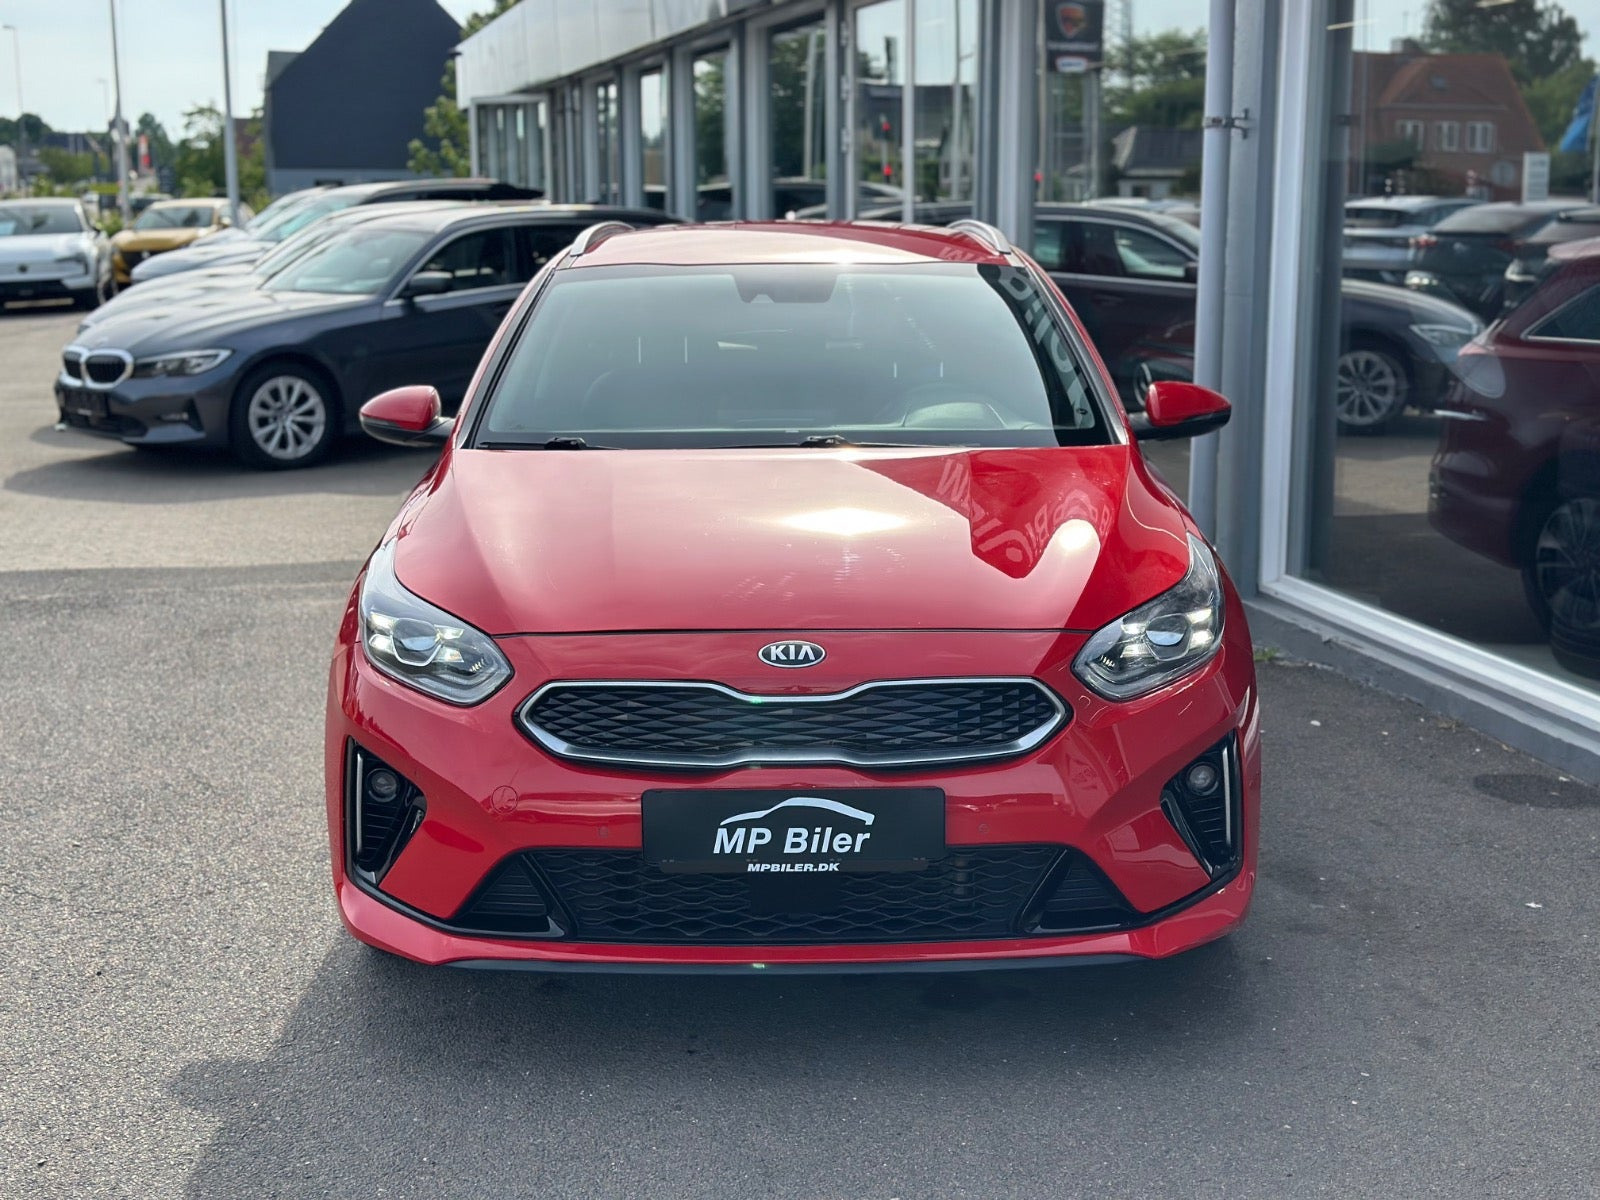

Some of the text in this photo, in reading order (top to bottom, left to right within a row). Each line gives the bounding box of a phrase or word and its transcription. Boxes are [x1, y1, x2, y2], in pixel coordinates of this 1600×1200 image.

[770, 645, 816, 661] KIA
[713, 826, 871, 854] MP Biler
[747, 862, 840, 872] MPBILER.DK
